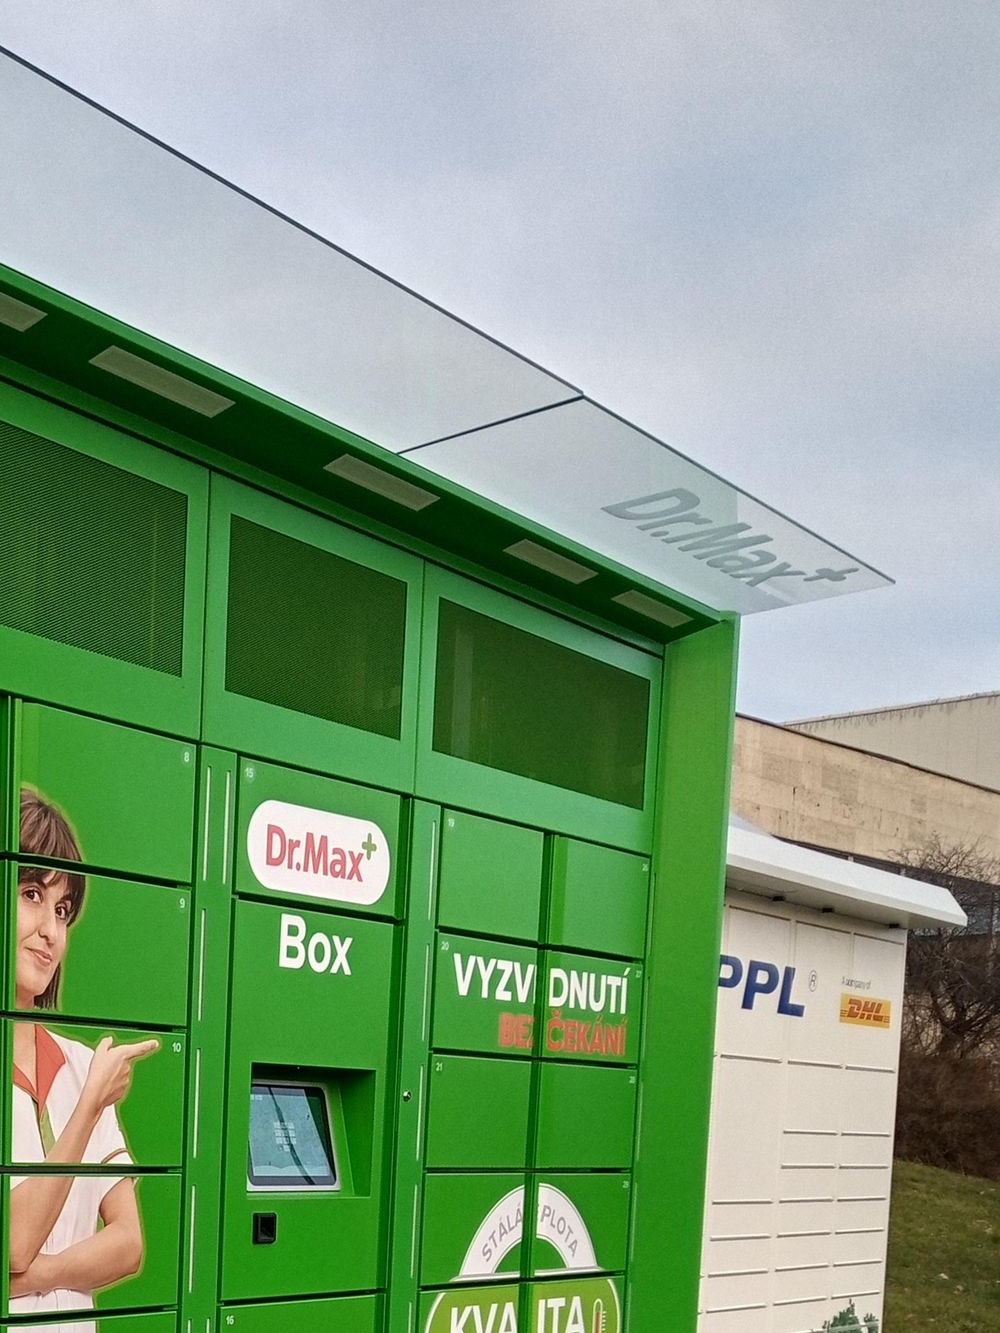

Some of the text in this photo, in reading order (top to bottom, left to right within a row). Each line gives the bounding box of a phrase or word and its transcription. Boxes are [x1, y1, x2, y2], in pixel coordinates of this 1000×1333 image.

[183, 751, 191, 764] 8
[244, 766, 255, 779] 15
[179, 897, 187, 910] 9
[278, 913, 353, 976] Box
[440, 940, 450, 952] 20
[453, 953, 630, 1015] VYZVDNUTÍ
[847, 998, 883, 1022] DHL
[547, 1009, 629, 1056] ČEKÁNÍ
[172, 1042, 182, 1053] 10
[435, 1061, 443, 1072] 21
[537, 1204, 578, 1258] PLOTA
[225, 1315, 235, 1327] 16
